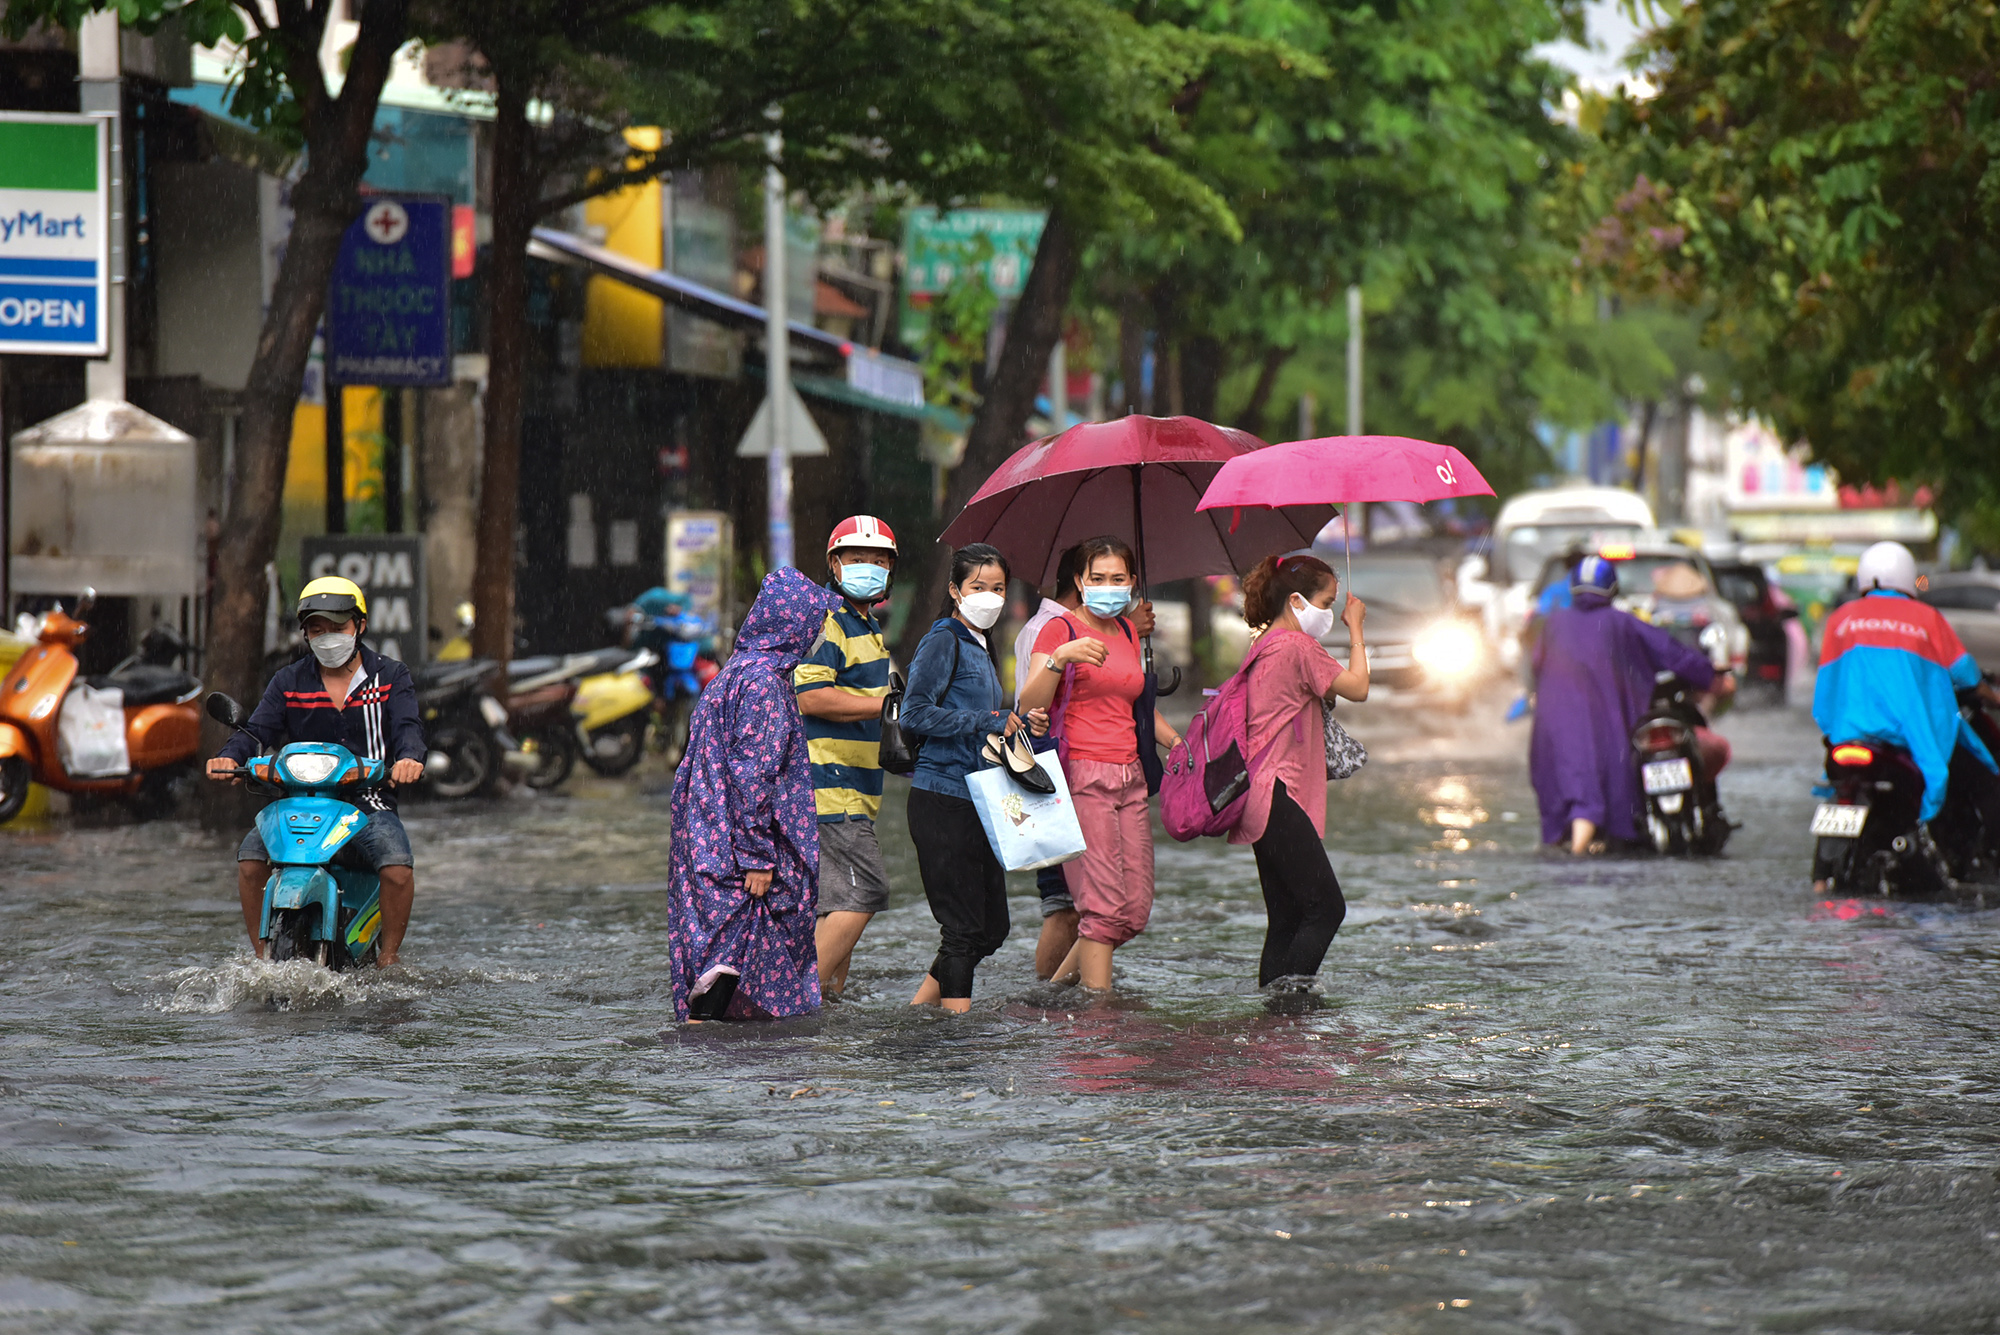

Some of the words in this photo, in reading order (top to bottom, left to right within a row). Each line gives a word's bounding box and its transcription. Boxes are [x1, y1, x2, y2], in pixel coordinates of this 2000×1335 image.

[0, 297, 85, 328] OPEN
[335, 356, 442, 377] PHARMACY
[1849, 617, 1928, 641] HONDA
